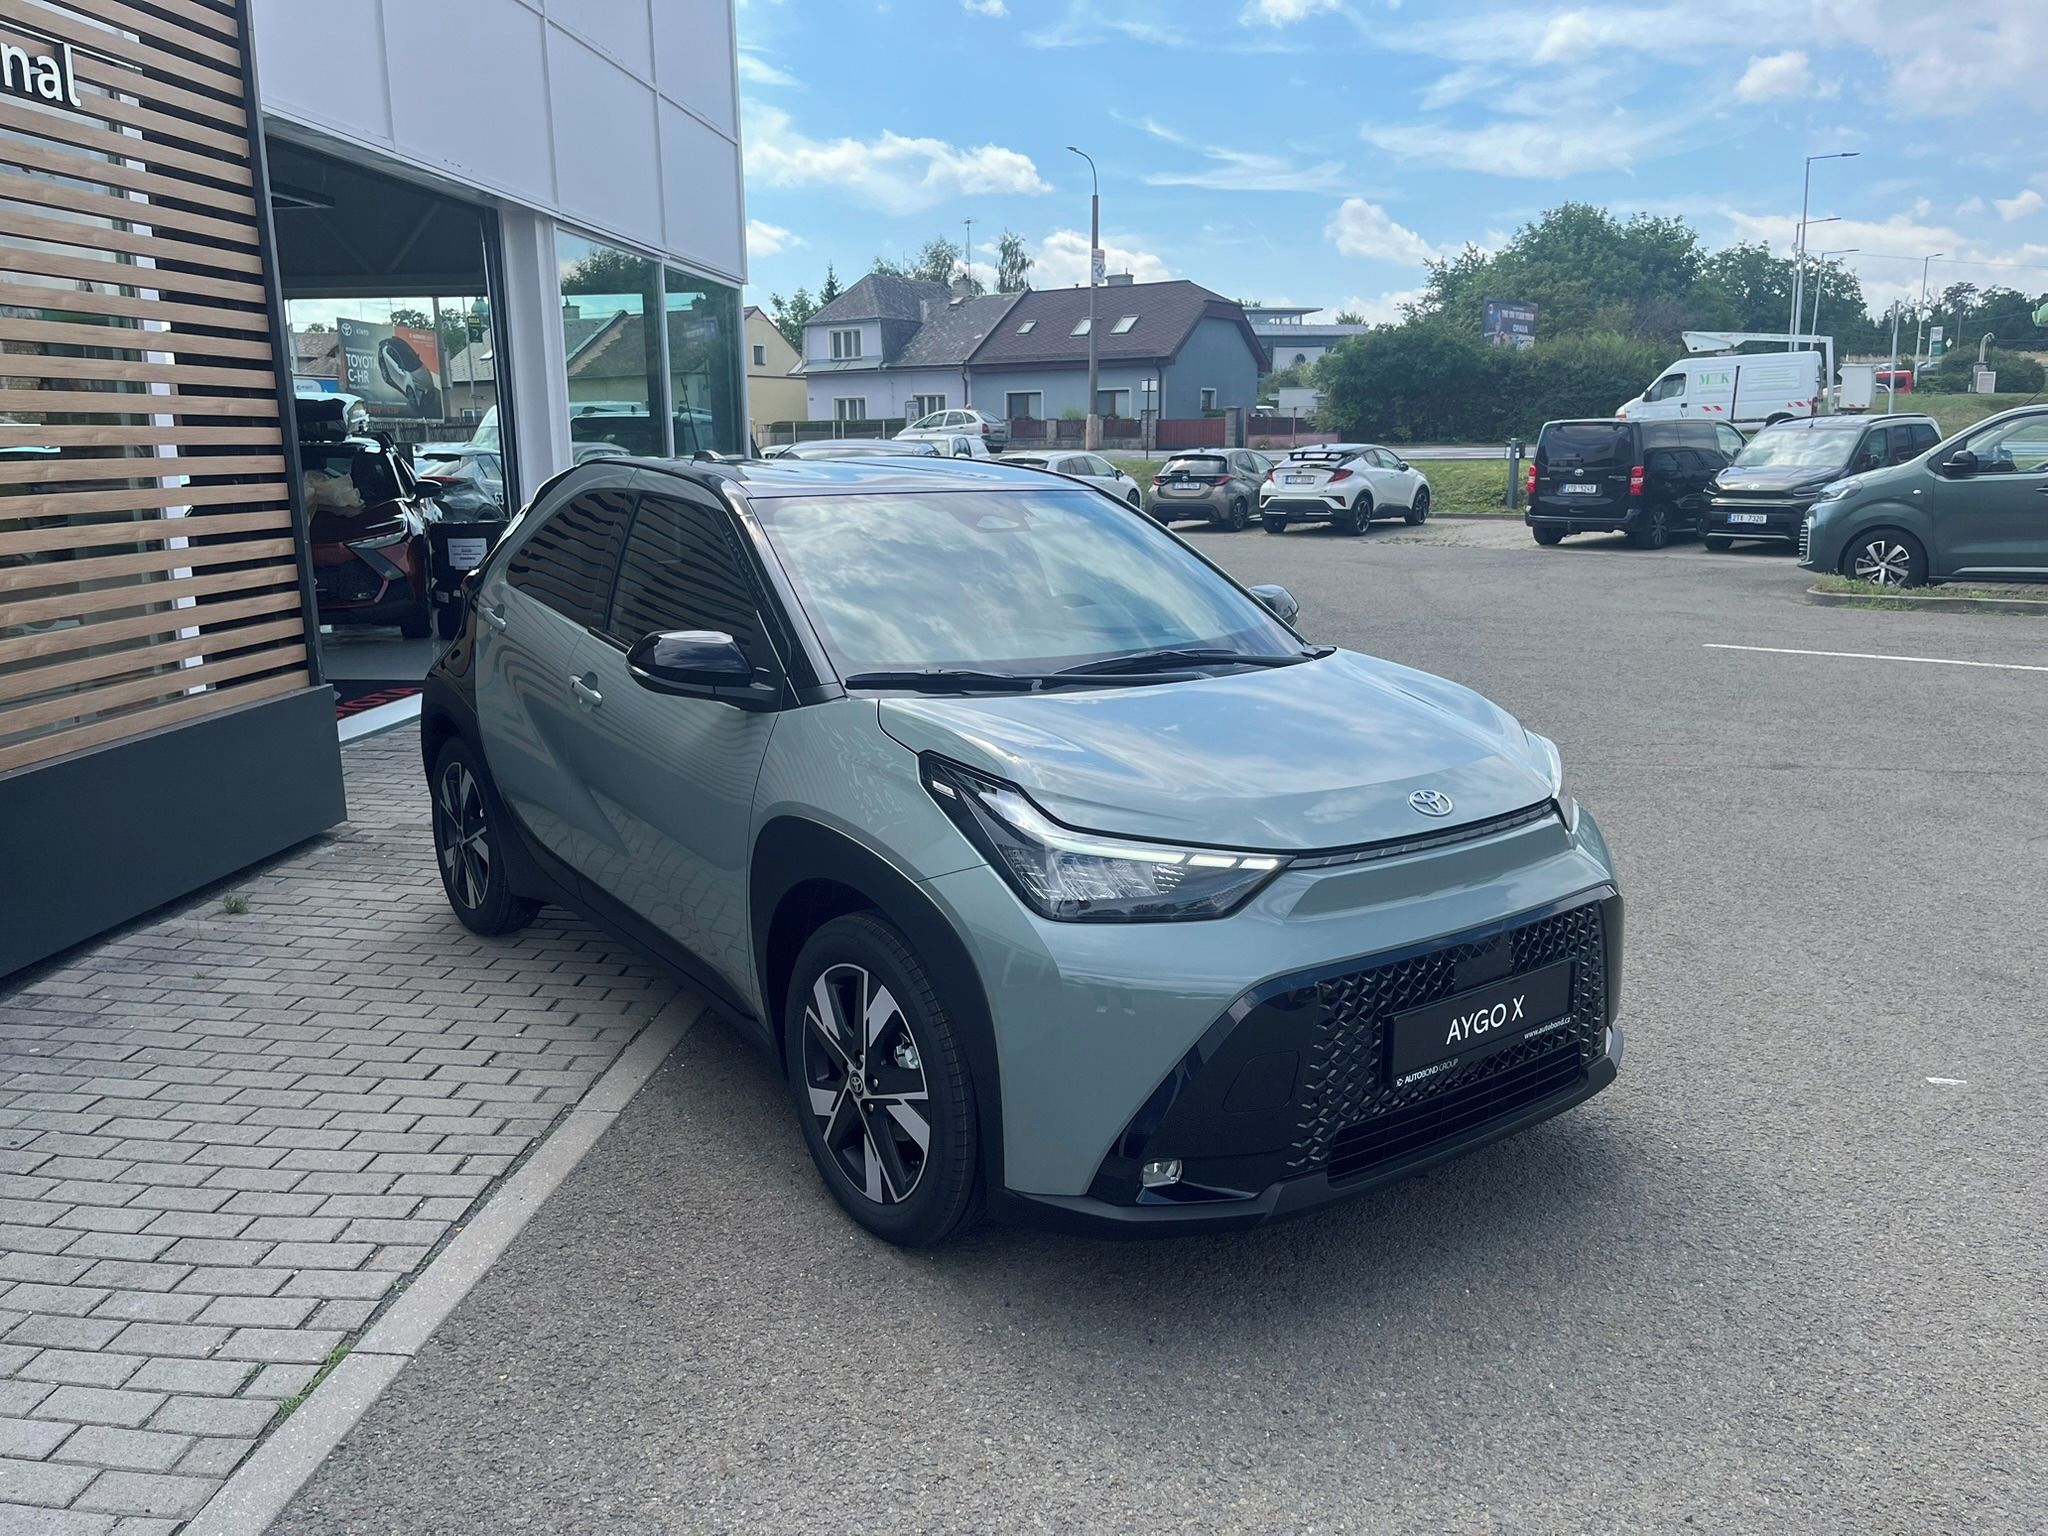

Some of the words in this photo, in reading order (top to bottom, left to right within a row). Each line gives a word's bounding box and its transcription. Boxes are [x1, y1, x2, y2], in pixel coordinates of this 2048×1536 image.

[345, 353, 378, 369] TOYOTA
[347, 368, 370, 384] C-HR
[1748, 514, 1764, 522] 7320
[1446, 1003, 1507, 1045] AYGO
[1511, 994, 1525, 1021] X
[1524, 1016, 1571, 1039] www.autobond.cz
[1404, 1065, 1438, 1084] AUTOBOND
[1438, 1057, 1459, 1072] GROUP
